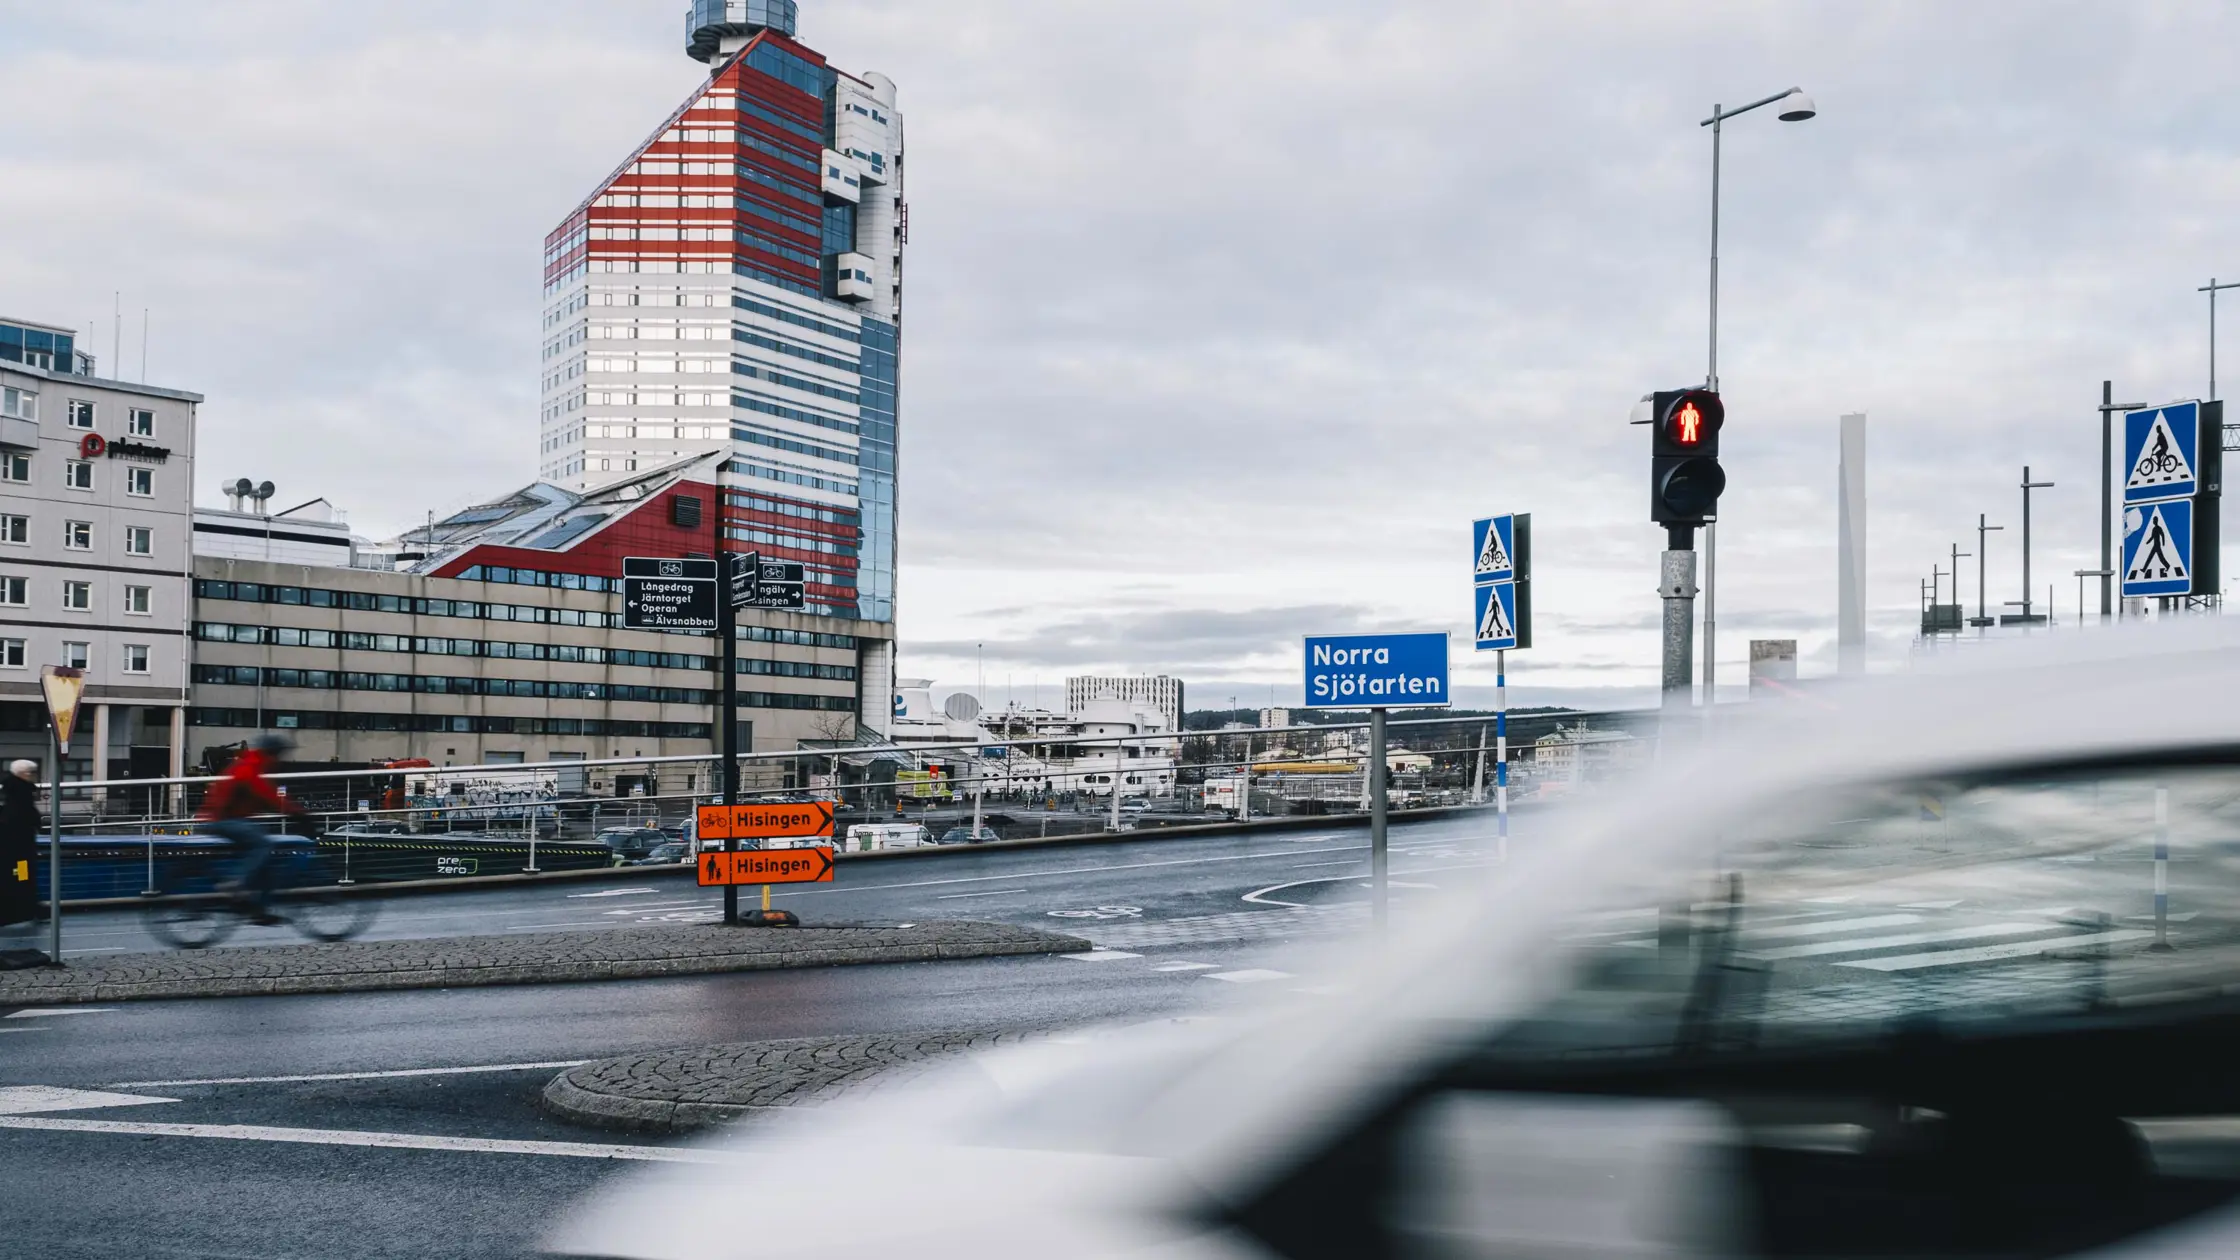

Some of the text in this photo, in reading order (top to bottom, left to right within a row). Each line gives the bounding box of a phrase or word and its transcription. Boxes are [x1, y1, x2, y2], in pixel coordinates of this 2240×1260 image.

[641, 581, 694, 594] Långedrag
[759, 585, 787, 595] ngälv
[641, 593, 692, 605] Järntorget
[751, 596, 789, 607] singen
[641, 603, 678, 614] Operan
[655, 613, 715, 627] Älvsnabben
[1313, 644, 1389, 666] Norra
[1313, 673, 1440, 701] Sjöfarten
[737, 812, 811, 829] Hisingen
[437, 857, 460, 866] pre
[737, 858, 811, 875] Hisingen
[437, 866, 467, 874] zero
